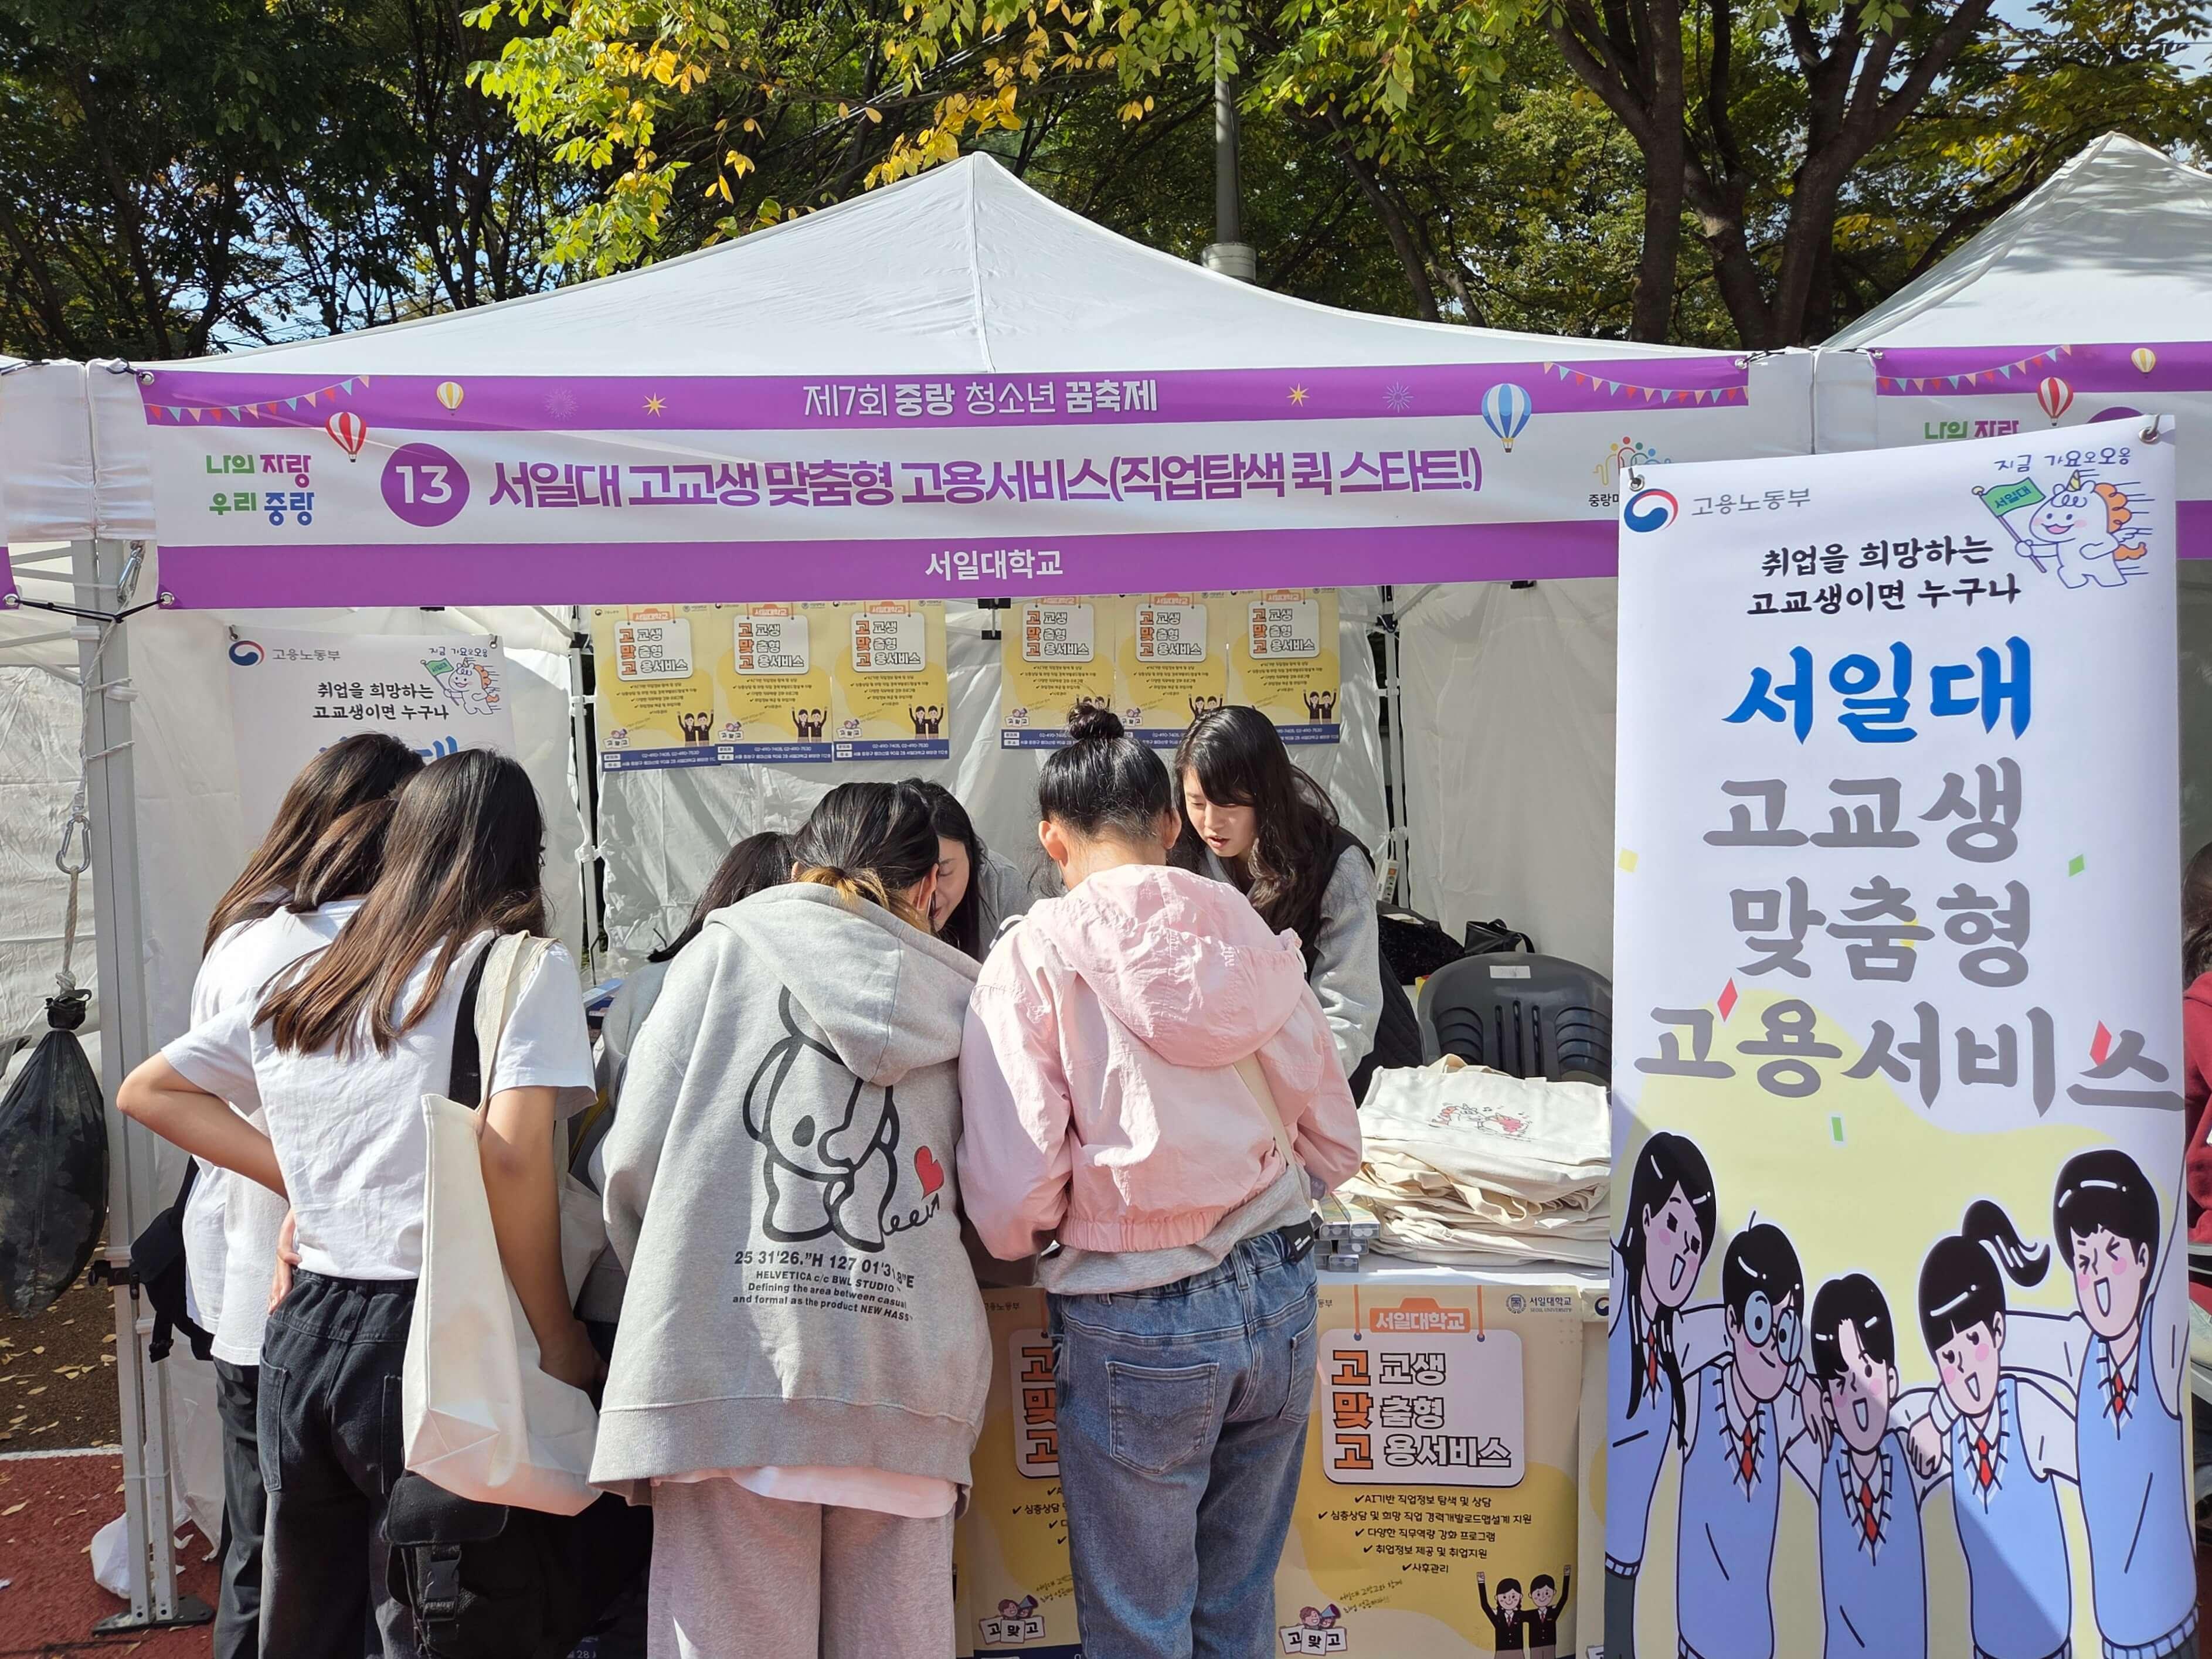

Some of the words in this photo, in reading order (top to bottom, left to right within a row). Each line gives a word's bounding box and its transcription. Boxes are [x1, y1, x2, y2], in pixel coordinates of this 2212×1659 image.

[803, 384, 888, 417] 제7회
[895, 383, 954, 417] 중랑
[966, 382, 1056, 416] 청소년
[1065, 379, 1157, 413] 꿈축제
[1925, 421, 1968, 439] 나의
[206, 454, 254, 474] 나의
[260, 454, 311, 488] 자랑
[1993, 454, 2031, 472] 지금
[395, 465, 453, 504] 13
[489, 461, 621, 508] 서일대
[628, 461, 759, 507] 고교생
[764, 459, 893, 508] 맞춤형
[1292, 450, 1332, 496] 퀵
[1340, 447, 1483, 492] 스타트!)
[1692, 488, 1812, 517] 고용노동부
[1994, 485, 2032, 508] 서일대
[209, 493, 256, 516] 우리
[264, 491, 314, 526] 중랑
[925, 550, 1063, 582] 서일대학교
[1761, 546, 1849, 577] 취업을
[1859, 536, 1993, 570] 희망하는
[1747, 582, 1905, 616] 고교생이면
[1918, 573, 2020, 607] 누구나
[272, 648, 341, 662] 고용노동부
[317, 682, 364, 699] 취업을
[370, 682, 434, 699] 희망하는
[1723, 636, 2032, 743] 서일대
[312, 704, 396, 720] 고교생이면
[402, 705, 449, 720] 누구나
[1703, 757, 2023, 862] 고교생
[1729, 875, 2031, 987] 맞춤형
[1635, 998, 2185, 1117] 고용서비스
[734, 1252, 753, 1264] 25
[830, 1255, 857, 1270] 127
[756, 1270, 811, 1281] HELVETICA
[814, 1274, 829, 1283] c/c
[832, 1276, 852, 1286] BWL
[855, 1279, 894, 1293] STUDIO
[733, 1295, 752, 1303] and
[755, 1295, 788, 1304] formal
[805, 1297, 818, 1306] the
[821, 1300, 858, 1313] product
[861, 1305, 883, 1315] NEW
[748, 1283, 790, 1293] Defining
[793, 1284, 808, 1293] the
[810, 1287, 831, 1296] area
[834, 1288, 875, 1302] between
[877, 1296, 907, 1309] casual
[1530, 1297, 1571, 1307] 서일대학교
[1376, 1312, 1465, 1330] 서일대학교
[1331, 1349, 1371, 1386] 고
[1379, 1351, 1446, 1386] 교생
[1334, 1433, 1373, 1470] 고
[1384, 1433, 1511, 1467] 용서비스
[1025, 1503, 1059, 1514] 심층상담
[1365, 1494, 1394, 1504] AI기반
[1398, 1495, 1435, 1505] 직업정보
[1438, 1495, 1456, 1506] 탐색
[1460, 1496, 1469, 1507] 및
[1472, 1497, 1491, 1507] 상담
[1331, 1511, 1367, 1521] 심층상담
[1370, 1511, 1379, 1521] 및
[1382, 1511, 1401, 1521] 희망
[1404, 1512, 1423, 1522] 직업
[1425, 1512, 1510, 1524] 경력개발로드맵설계
[1513, 1514, 1531, 1524] 지원
[1368, 1529, 1396, 1538] 다양한
[1399, 1529, 1435, 1539] 직무역량
[1439, 1529, 1457, 1540] 강화
[1460, 1531, 1496, 1542] 프로그램
[1375, 1545, 1413, 1555] 취업정보
[1415, 1546, 1433, 1556] 제공
[1436, 1546, 1446, 1557] 및
[1449, 1547, 1487, 1559] 취업지원
[1412, 1563, 1449, 1574] 사후관리
